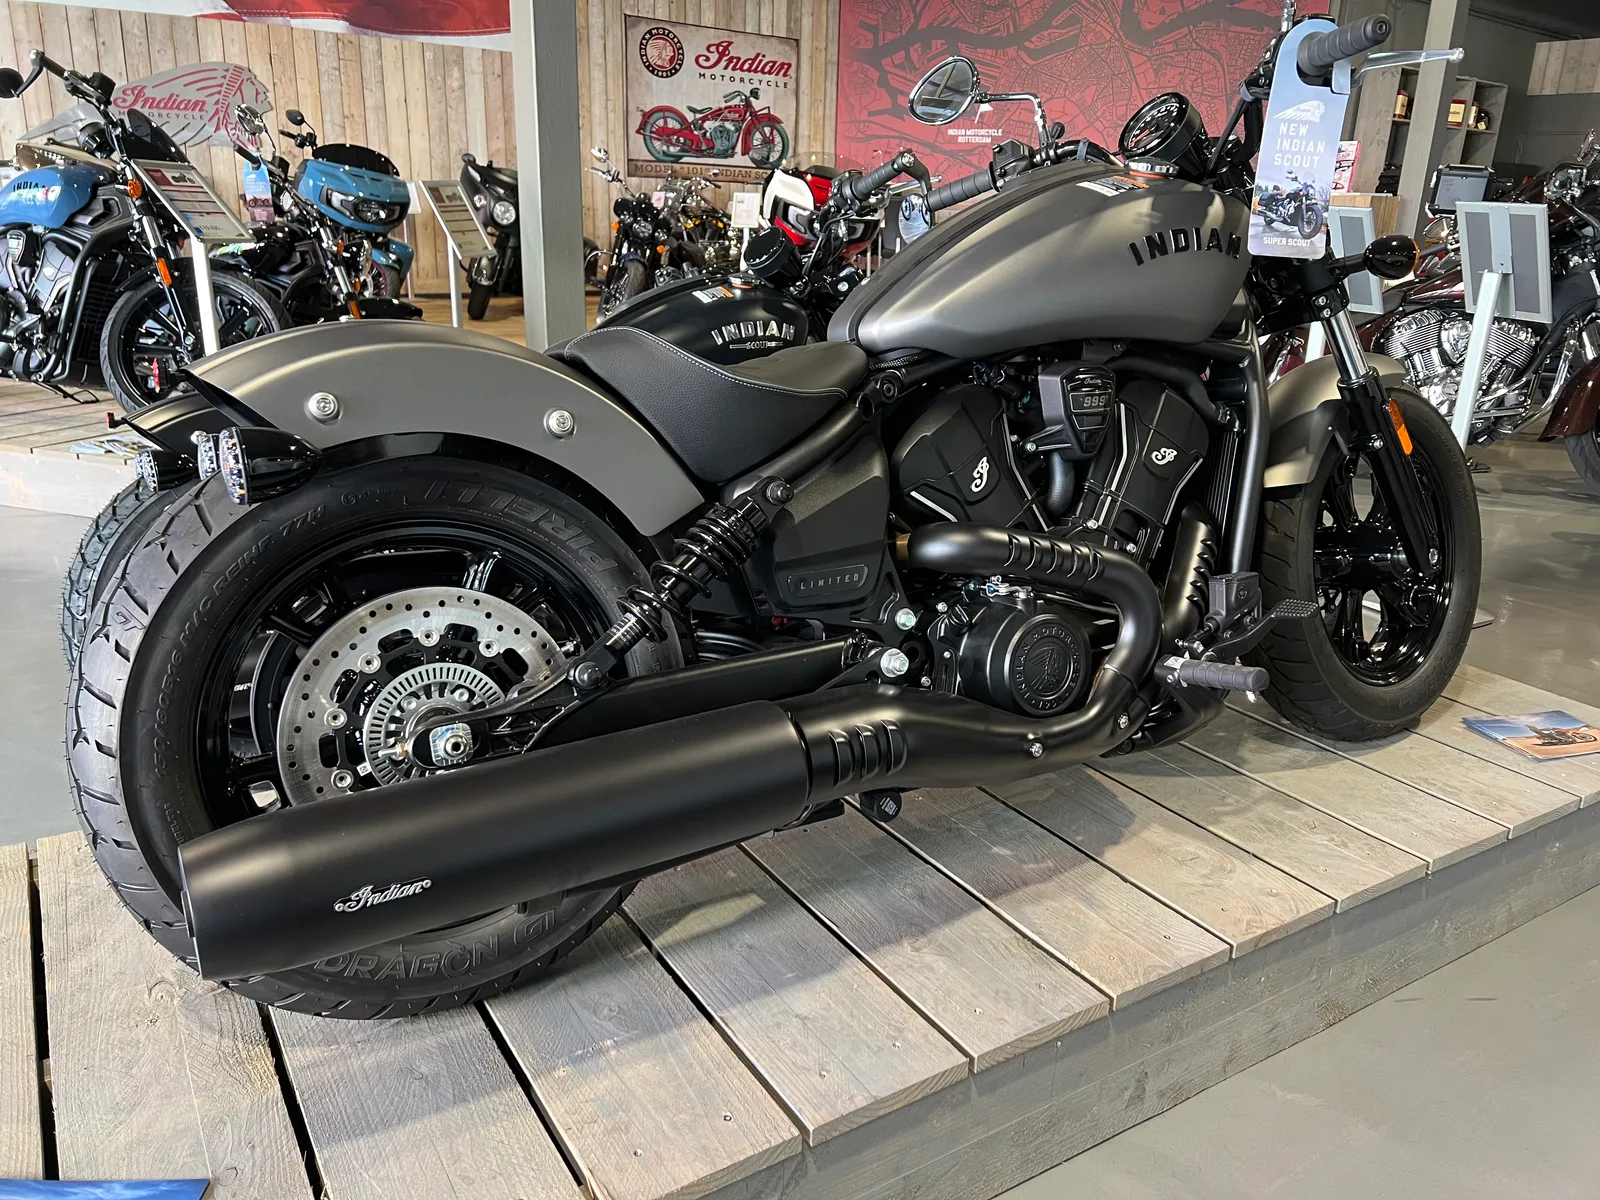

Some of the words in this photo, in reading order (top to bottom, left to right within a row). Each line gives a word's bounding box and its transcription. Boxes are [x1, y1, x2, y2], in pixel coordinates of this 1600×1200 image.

[640, 33, 651, 66] INDIAN
[651, 28, 684, 70] MOTORCYCLE
[694, 40, 792, 78] Indian
[698, 72, 788, 89] MOTORCYCLE
[113, 85, 207, 112] Indian
[118, 110, 205, 120] MORCYCLE
[965, 128, 1003, 136] MOTORCYCLE
[1279, 122, 1309, 137] NEW
[1276, 139, 1325, 153] INDIAN
[1273, 153, 1320, 168] SCOUT
[634, 164, 676, 174] MODEL
[718, 168, 751, 179] NDIAN
[1127, 225, 1241, 267] INDIAN
[1263, 236, 1288, 246] SUPER
[1287, 237, 1311, 247] SCOUT
[711, 320, 795, 346] INDIAN
[746, 341, 769, 350] SCOUT
[800, 573, 859, 590] LIMITED
[343, 881, 424, 912] Indian
[313, 934, 498, 980] DRAGON
